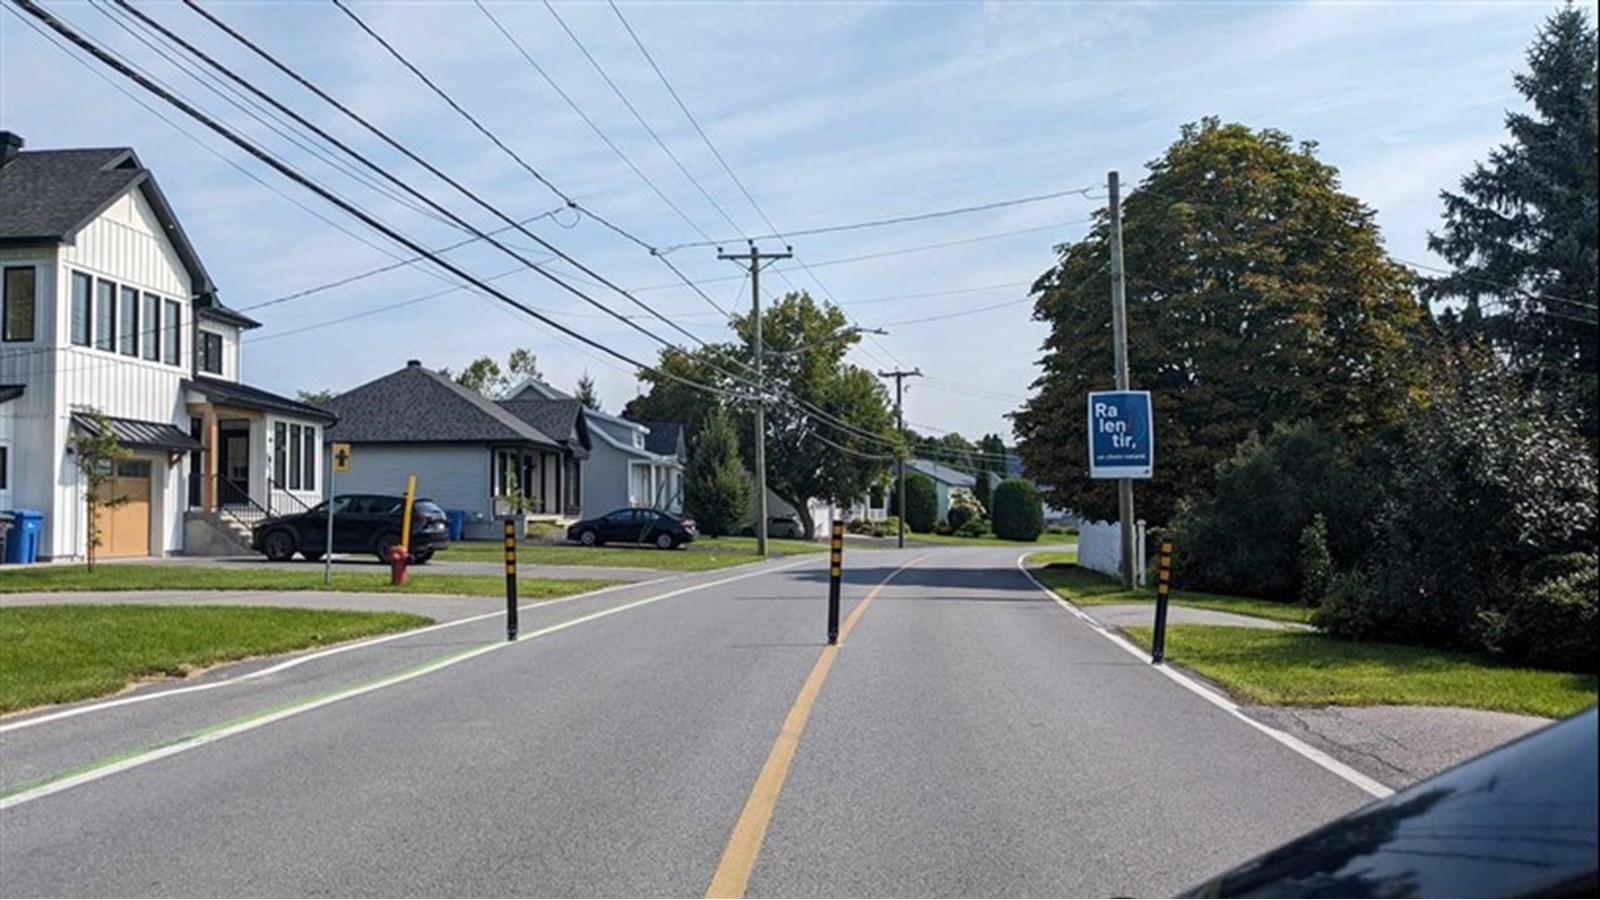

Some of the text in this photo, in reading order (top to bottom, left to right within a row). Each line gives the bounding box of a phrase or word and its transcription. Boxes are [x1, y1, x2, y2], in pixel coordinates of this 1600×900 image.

[1095, 403, 1118, 418] Ra
[1099, 418, 1126, 433] len
[1112, 432, 1137, 449] tir,
